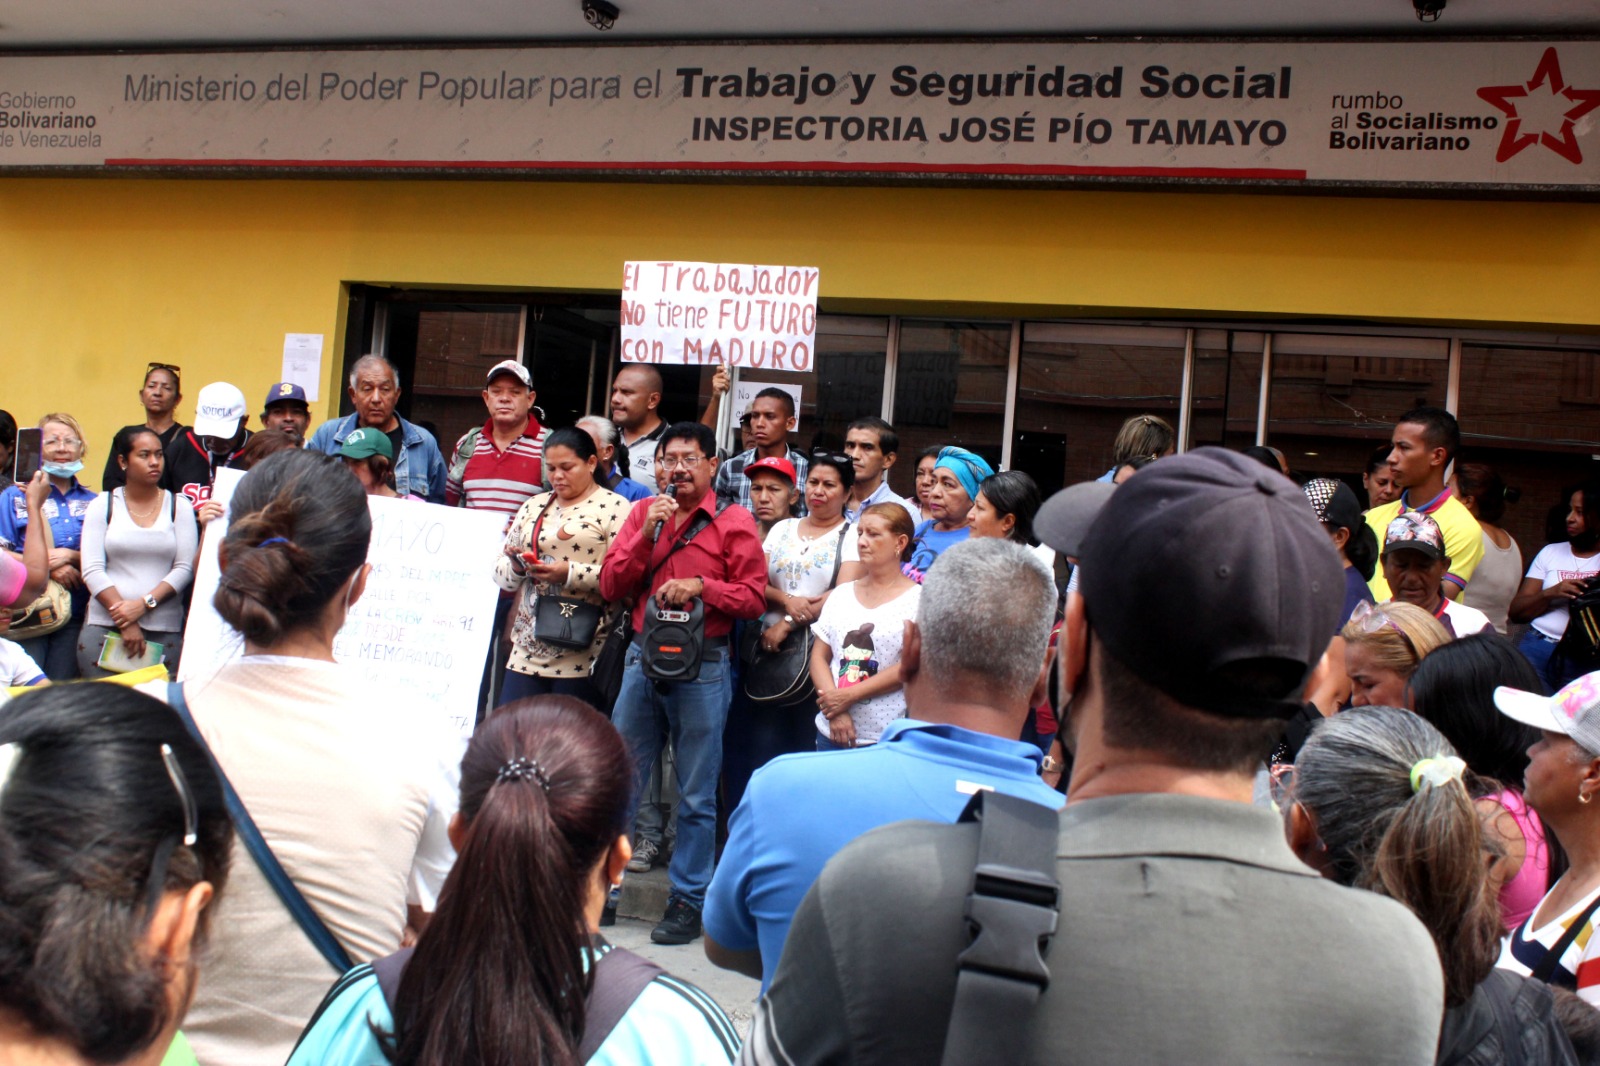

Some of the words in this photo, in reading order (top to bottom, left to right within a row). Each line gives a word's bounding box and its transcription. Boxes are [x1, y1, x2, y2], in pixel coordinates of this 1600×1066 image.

[124, 73, 256, 101] Ministerio
[266, 73, 308, 101] del
[319, 71, 409, 101] Poder
[418, 70, 540, 107] Popular
[549, 76, 621, 107] para
[633, 69, 661, 98] el
[675, 67, 837, 106] Trabajo
[849, 71, 876, 106] y
[889, 66, 1122, 102] Seguridad
[1140, 66, 1292, 100] Social
[0, 91, 77, 109] Gobierno
[1331, 91, 1404, 109] rumbo
[0, 111, 97, 129] Bolivariano
[691, 116, 928, 143] INSPECTORIA
[939, 111, 1036, 144] JOSÉ
[1048, 111, 1113, 146] PÍO
[1125, 118, 1288, 147] TAMAYO
[1330, 112, 1349, 129] al
[1355, 111, 1498, 130] Socialismo
[19, 130, 102, 148] Venezuela
[1329, 131, 1470, 151] Bolivariano
[623, 264, 640, 292] El
[657, 262, 818, 297] Trabajador
[655, 299, 708, 329] tiene
[718, 299, 816, 337] FUTURO
[621, 338, 664, 364] con
[683, 337, 809, 371] MADURO
[280, 383, 293, 396] B
